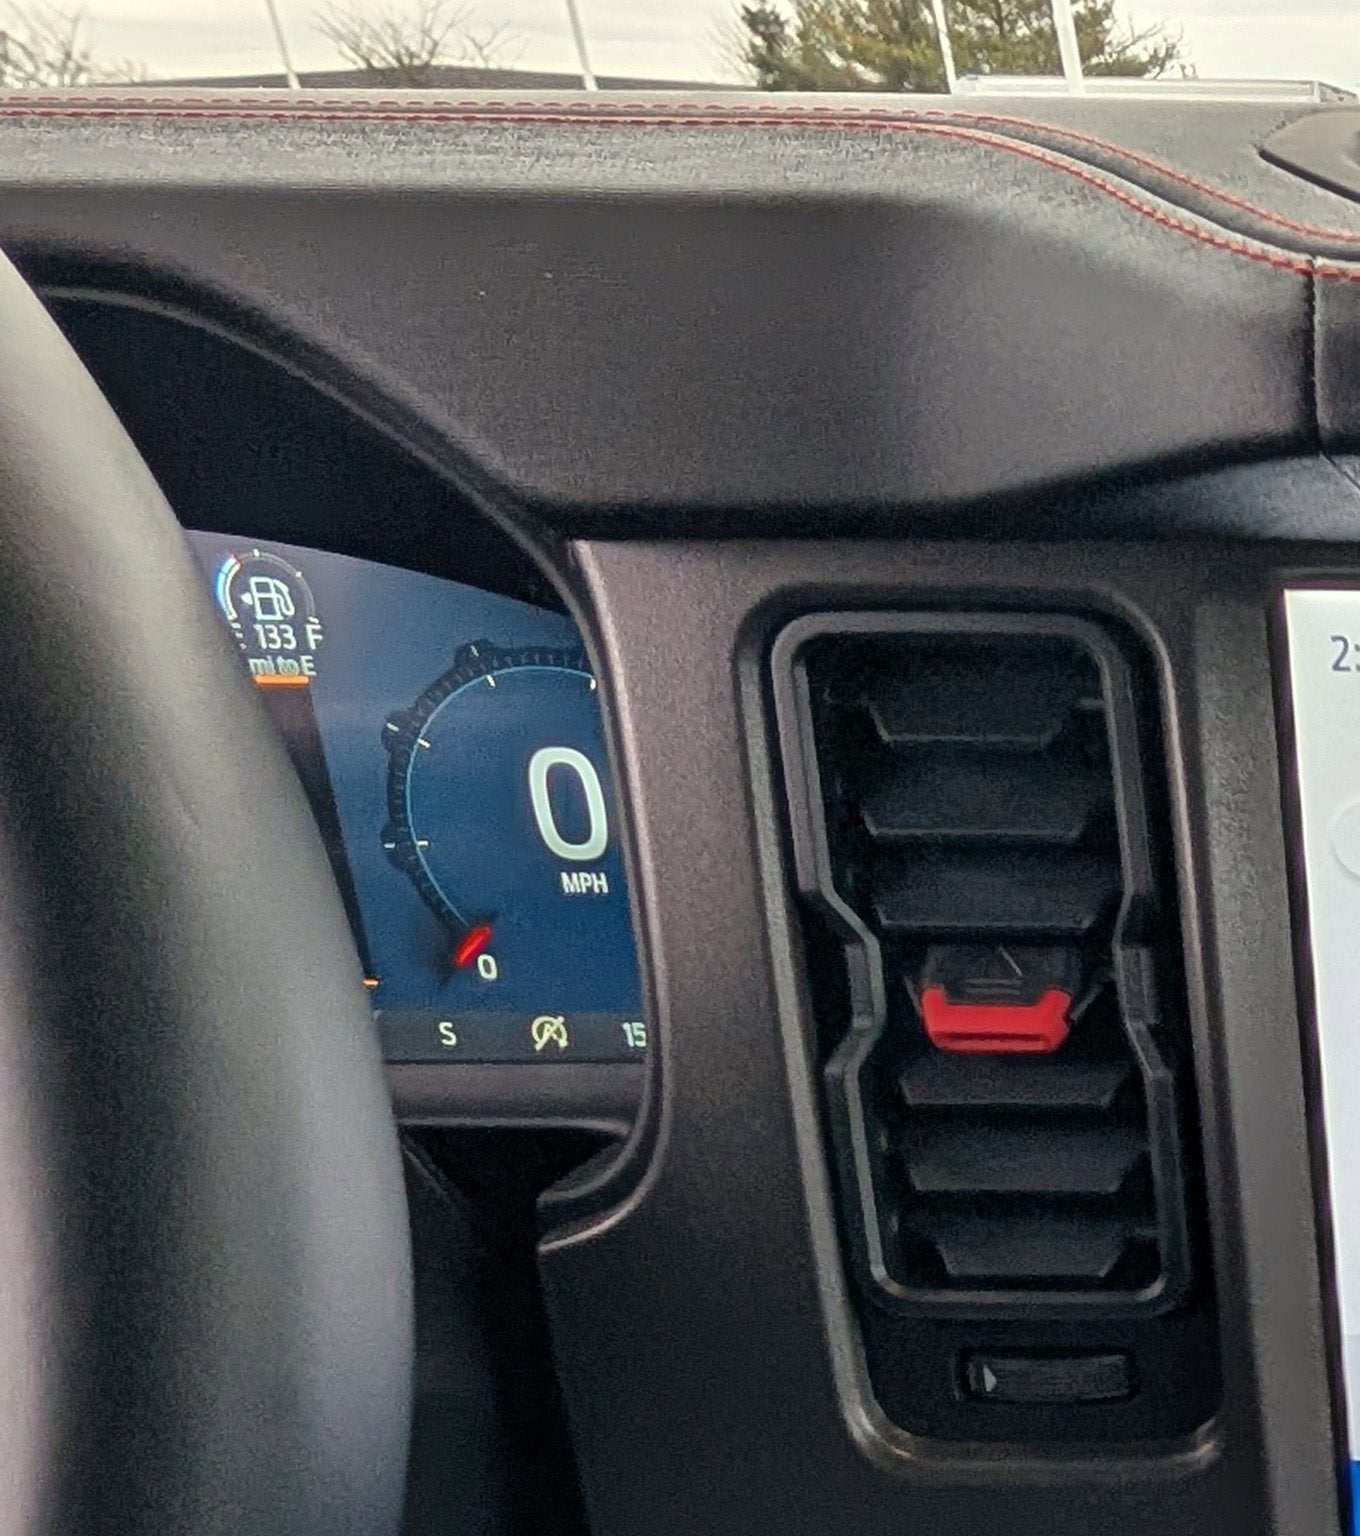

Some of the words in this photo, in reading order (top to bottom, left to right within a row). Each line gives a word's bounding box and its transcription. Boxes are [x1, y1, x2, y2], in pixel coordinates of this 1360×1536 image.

[252, 624, 298, 650] 133
[304, 623, 323, 650] F
[300, 655, 318, 677] E
[527, 746, 609, 862] 0
[560, 871, 608, 894] MPH
[476, 953, 498, 980] 0
[438, 1021, 458, 1047] S
